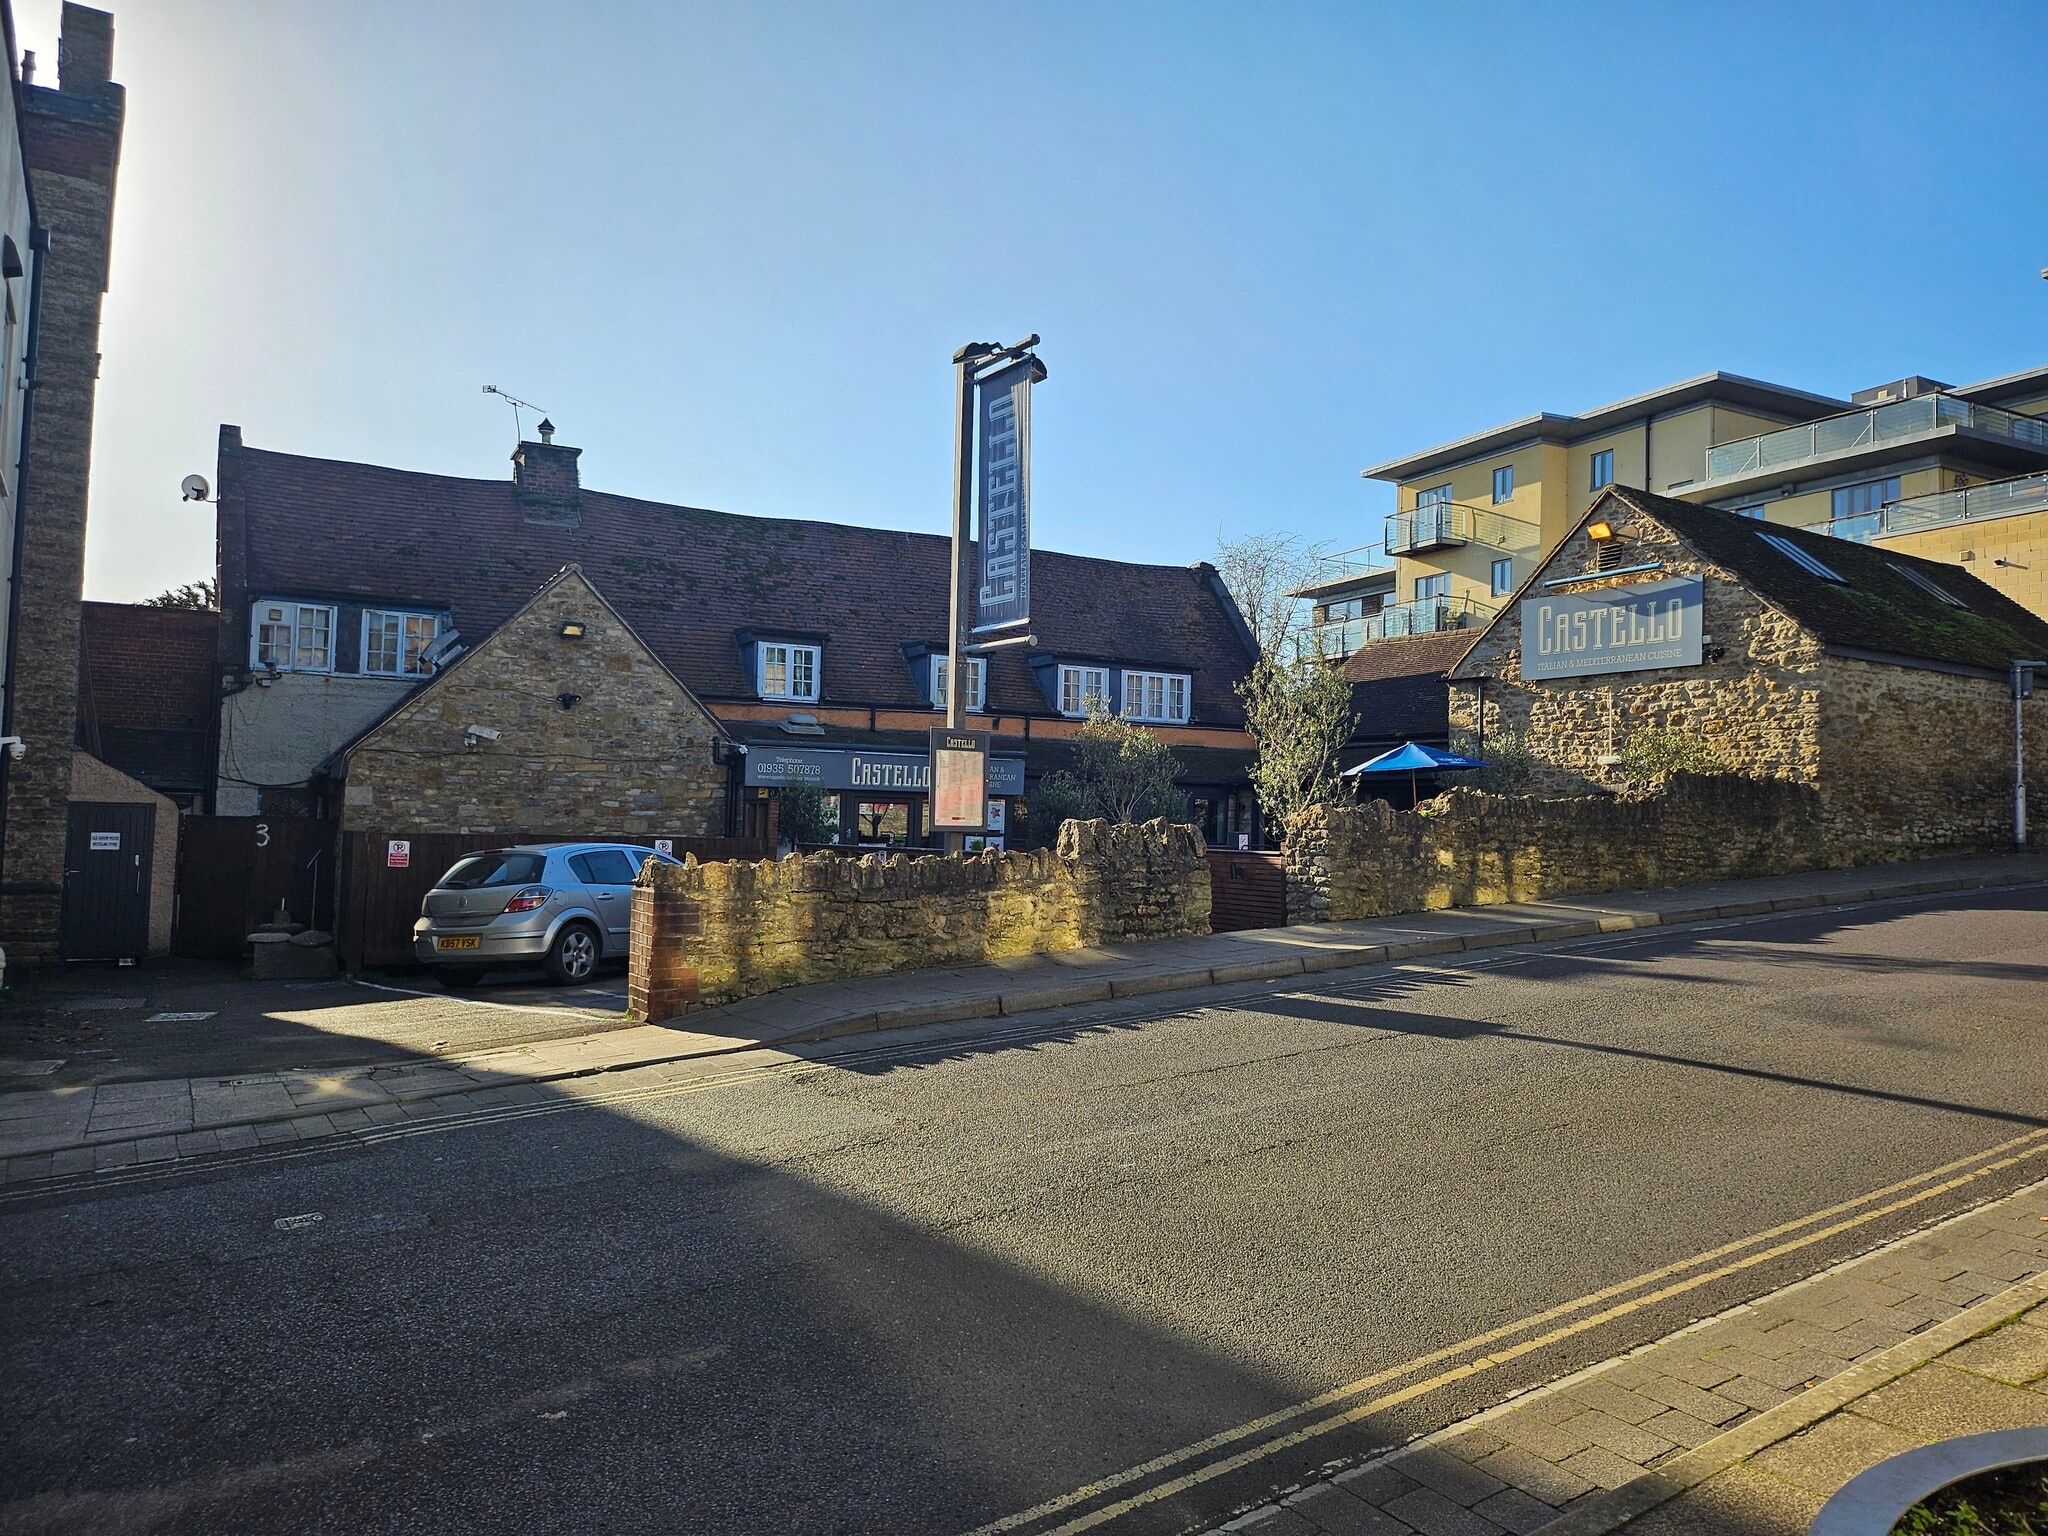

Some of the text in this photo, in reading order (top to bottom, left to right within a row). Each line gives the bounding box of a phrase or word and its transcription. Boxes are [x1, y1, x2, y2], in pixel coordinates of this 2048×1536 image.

[980, 393, 1018, 608] CASTELLO
[1537, 598, 1683, 656] CASTELLO
[1537, 649, 1682, 671] ITALIAN & MEDITERRANEAN CUISINE
[947, 736, 976, 749] CASTELLO
[757, 762, 821, 775] 01935 507878
[852, 757, 930, 787] CASTELLO
[256, 823, 270, 847] 3
